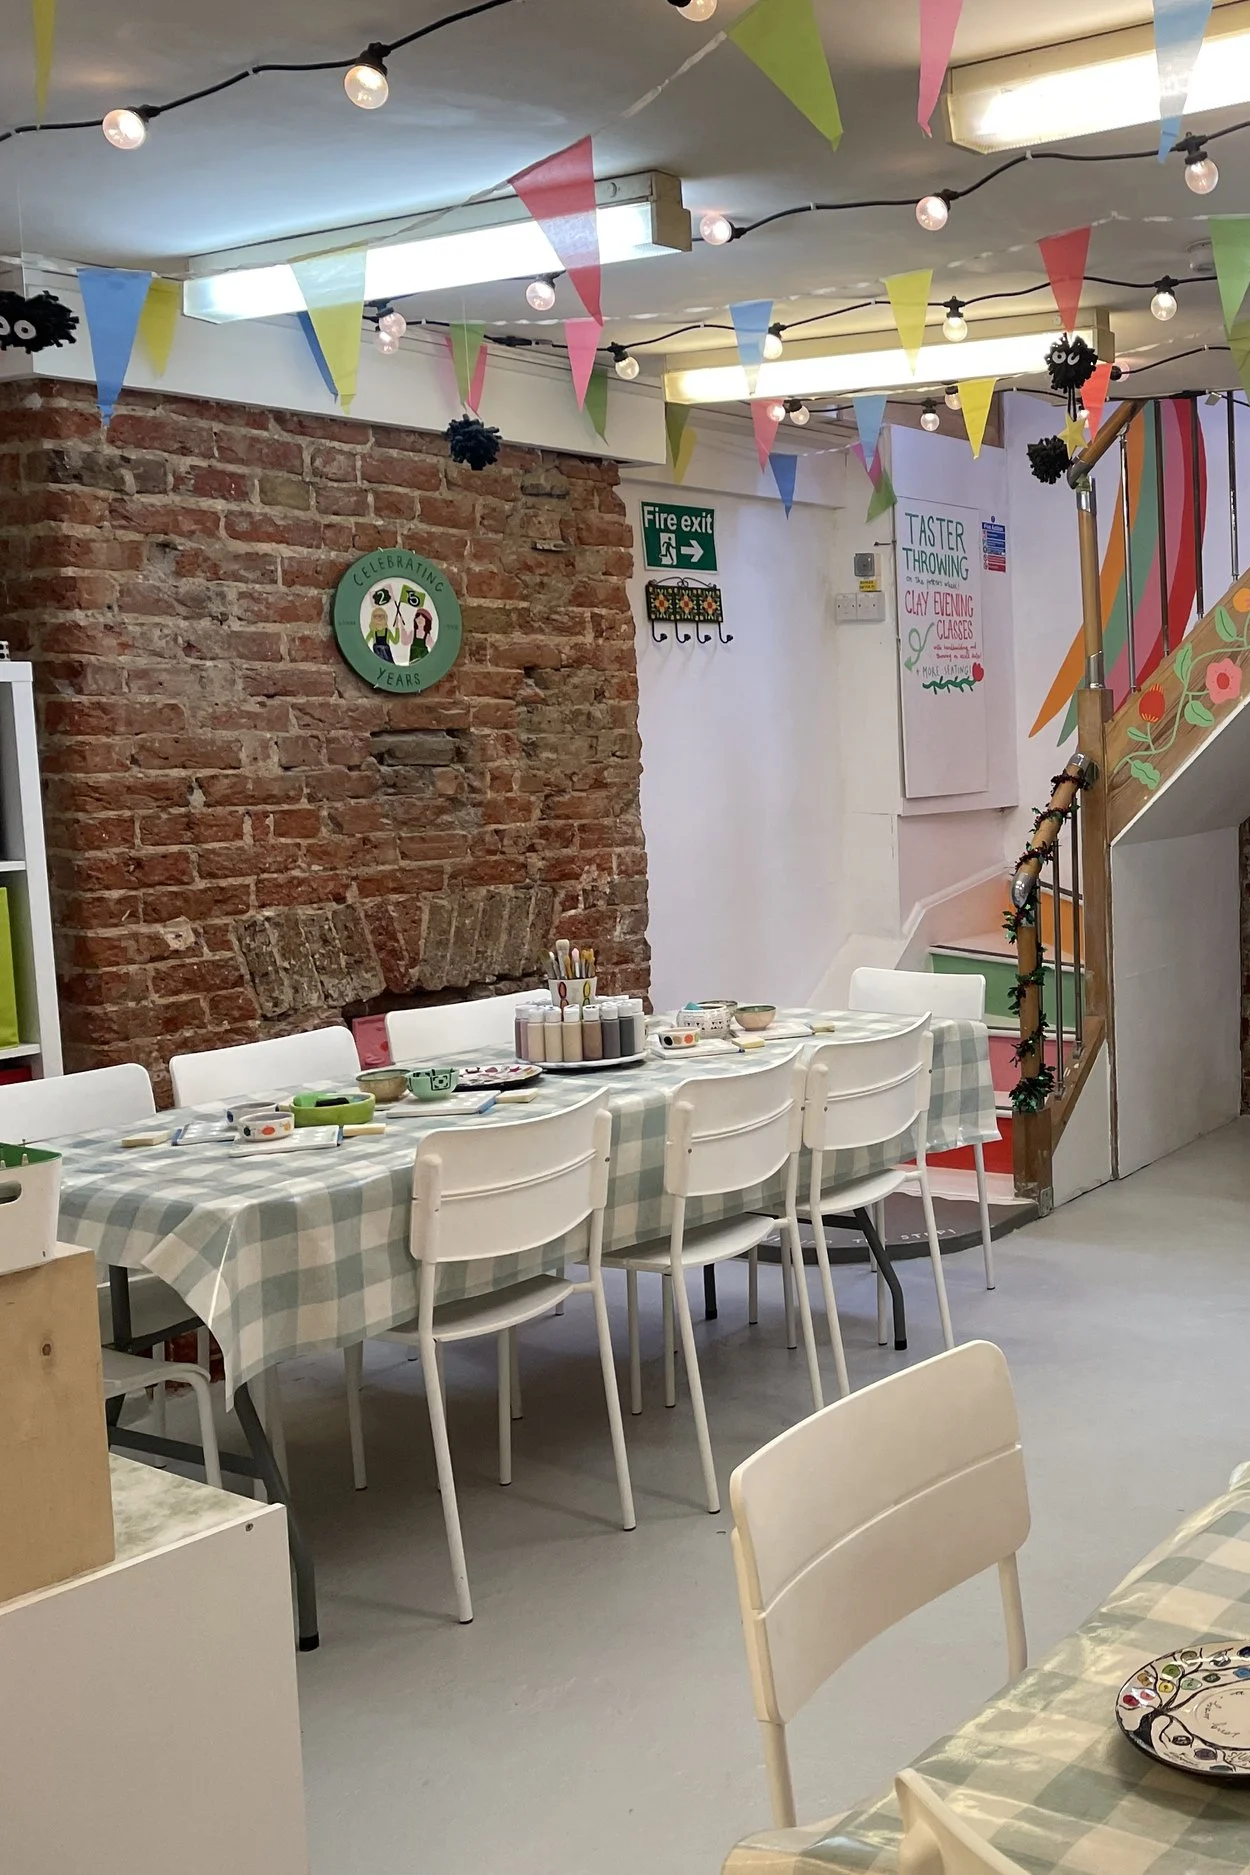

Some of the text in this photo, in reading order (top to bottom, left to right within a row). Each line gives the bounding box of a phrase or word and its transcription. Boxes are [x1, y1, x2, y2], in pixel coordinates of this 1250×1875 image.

[643, 506, 712, 534] Fire exit
[905, 512, 966, 554] TASTER
[353, 555, 444, 593] CELEBRATING
[902, 547, 969, 581] THROWING
[905, 590, 974, 618] CLAY EVENING
[937, 620, 973, 640] CLASSES
[376, 667, 421, 686] YEARS
[922, 665, 940, 677] MORE
[900, 1228, 957, 1241] STP!
